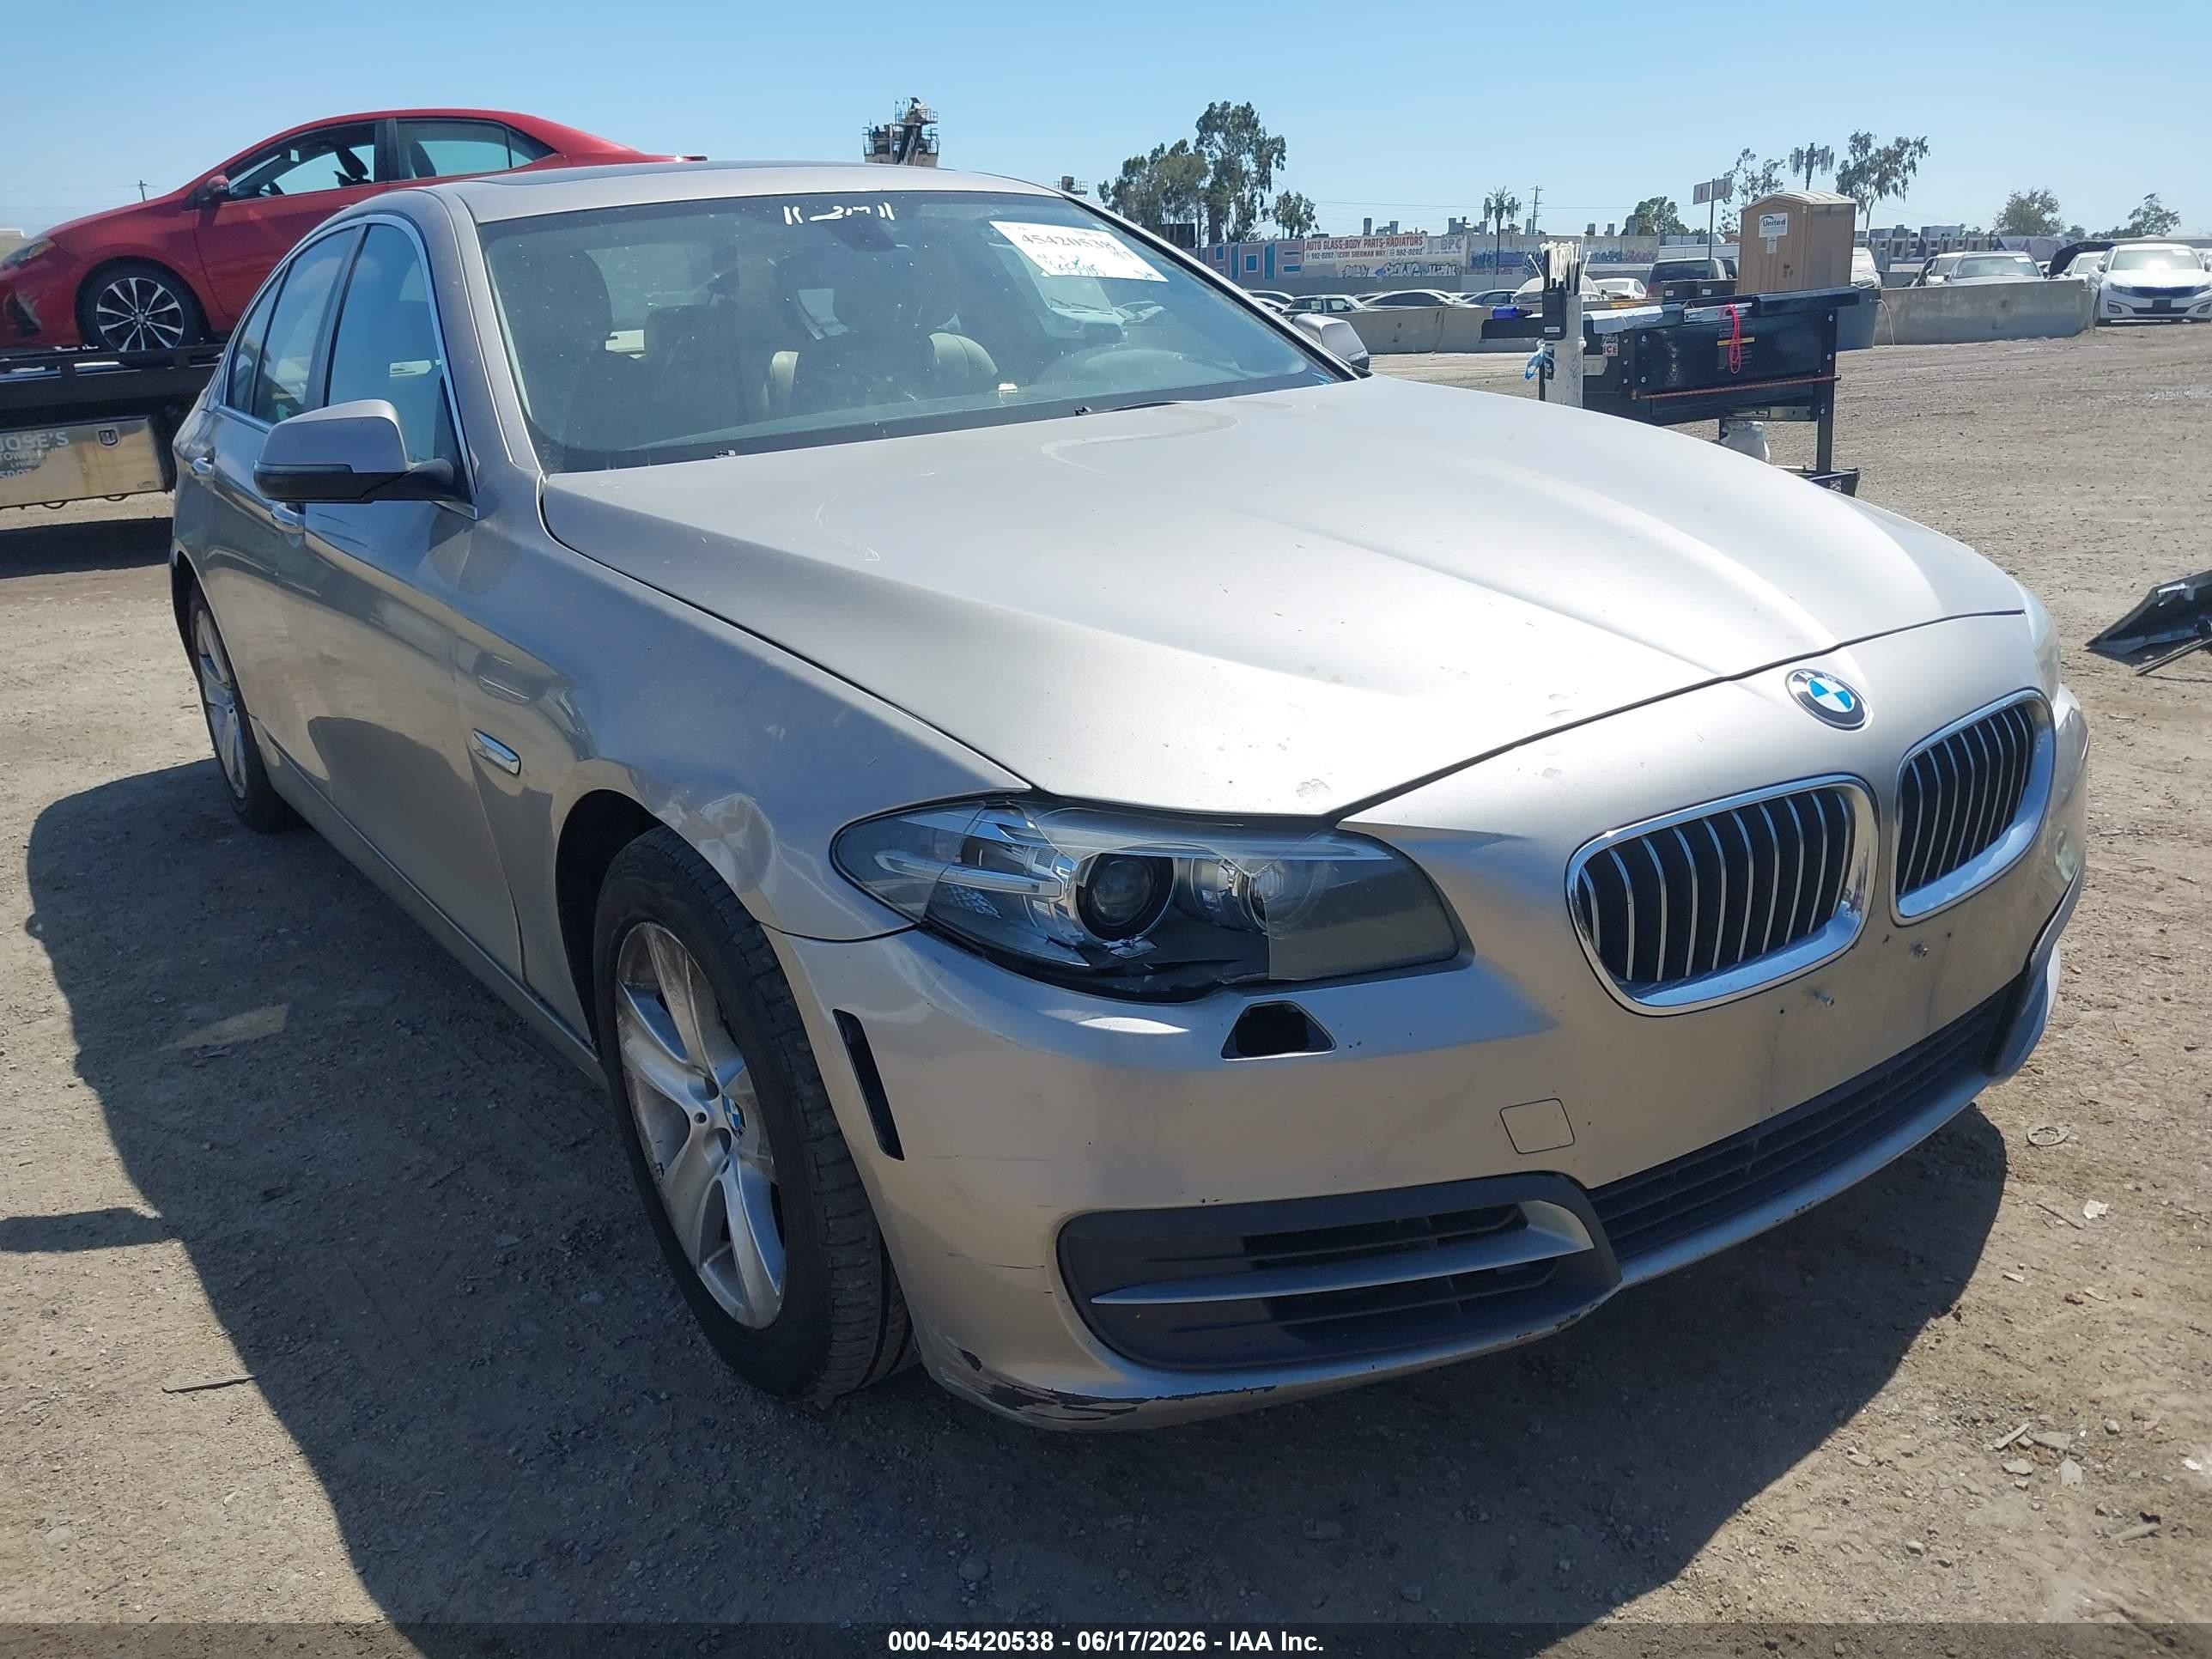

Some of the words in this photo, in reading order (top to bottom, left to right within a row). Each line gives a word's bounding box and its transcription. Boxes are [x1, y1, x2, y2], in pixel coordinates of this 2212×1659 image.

[1762, 218, 1786, 227] United
[1305, 240, 1322, 251] AUTO
[1603, 345, 1618, 354] ICE
